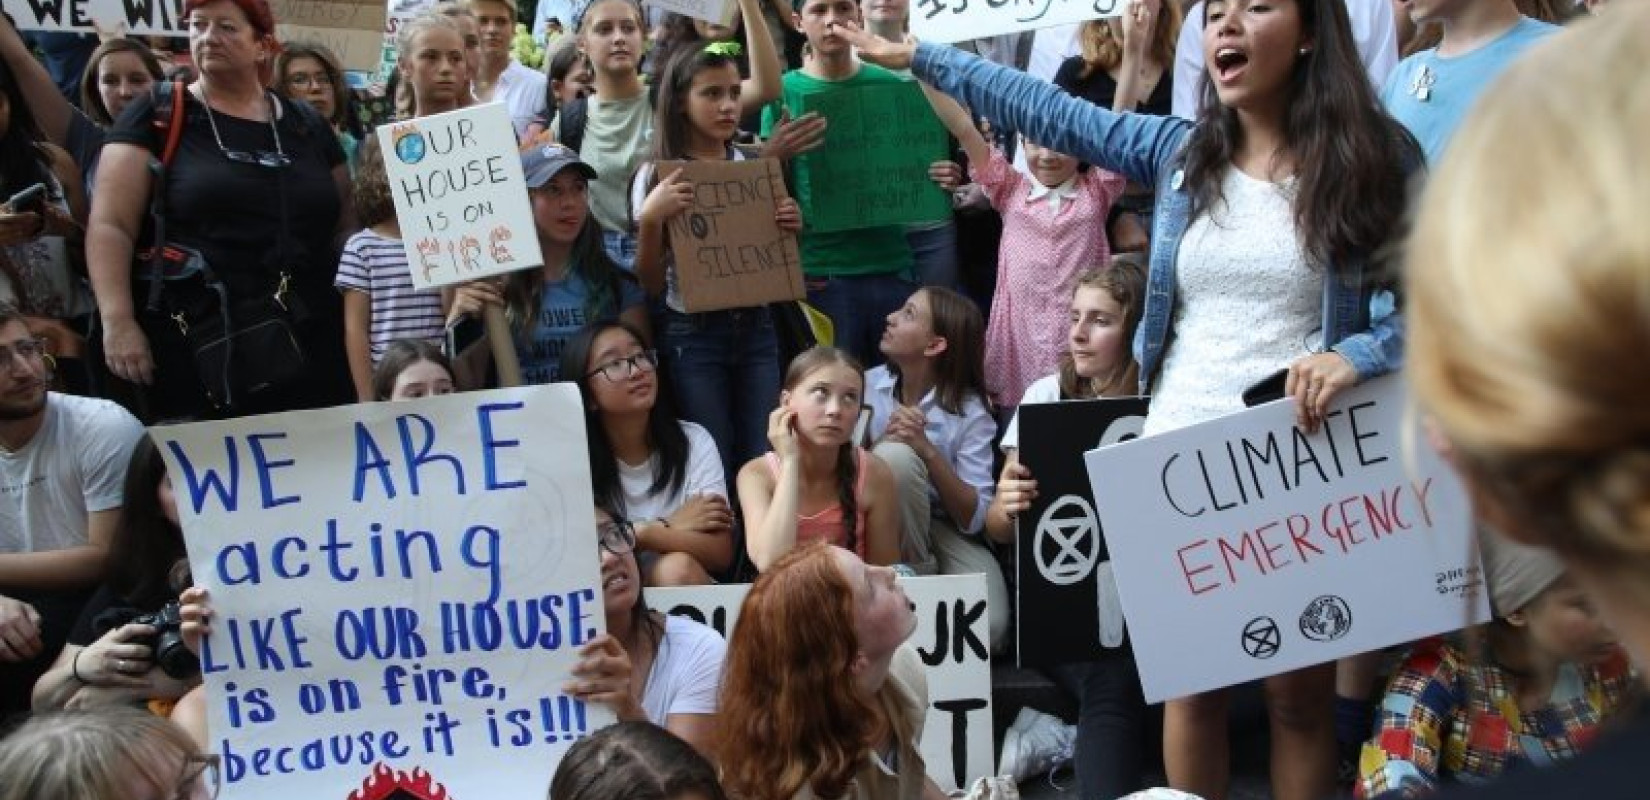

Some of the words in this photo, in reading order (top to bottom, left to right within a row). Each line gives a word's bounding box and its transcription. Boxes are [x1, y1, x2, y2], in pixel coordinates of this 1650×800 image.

[27, 0, 93, 26] WE
[395, 119, 477, 165] OUR
[402, 156, 508, 208] HOUSE
[427, 212, 448, 232] IS
[464, 201, 493, 222] ON
[669, 211, 724, 241] NOT
[416, 226, 515, 282] FIRE
[697, 237, 798, 278] SILENCE
[167, 432, 300, 514] WE
[353, 402, 526, 502] ARE
[1161, 401, 1388, 517] CLIMATE
[216, 518, 502, 602] acting
[1177, 478, 1432, 595] EMERGENCY
[202, 608, 311, 673] LIKE
[335, 607, 427, 661] OUR
[441, 589, 597, 654] HOUSE
[225, 682, 276, 728] is
[299, 678, 361, 715] on
[382, 665, 507, 706] fire,
[222, 729, 410, 783] because
[423, 712, 461, 756] it
